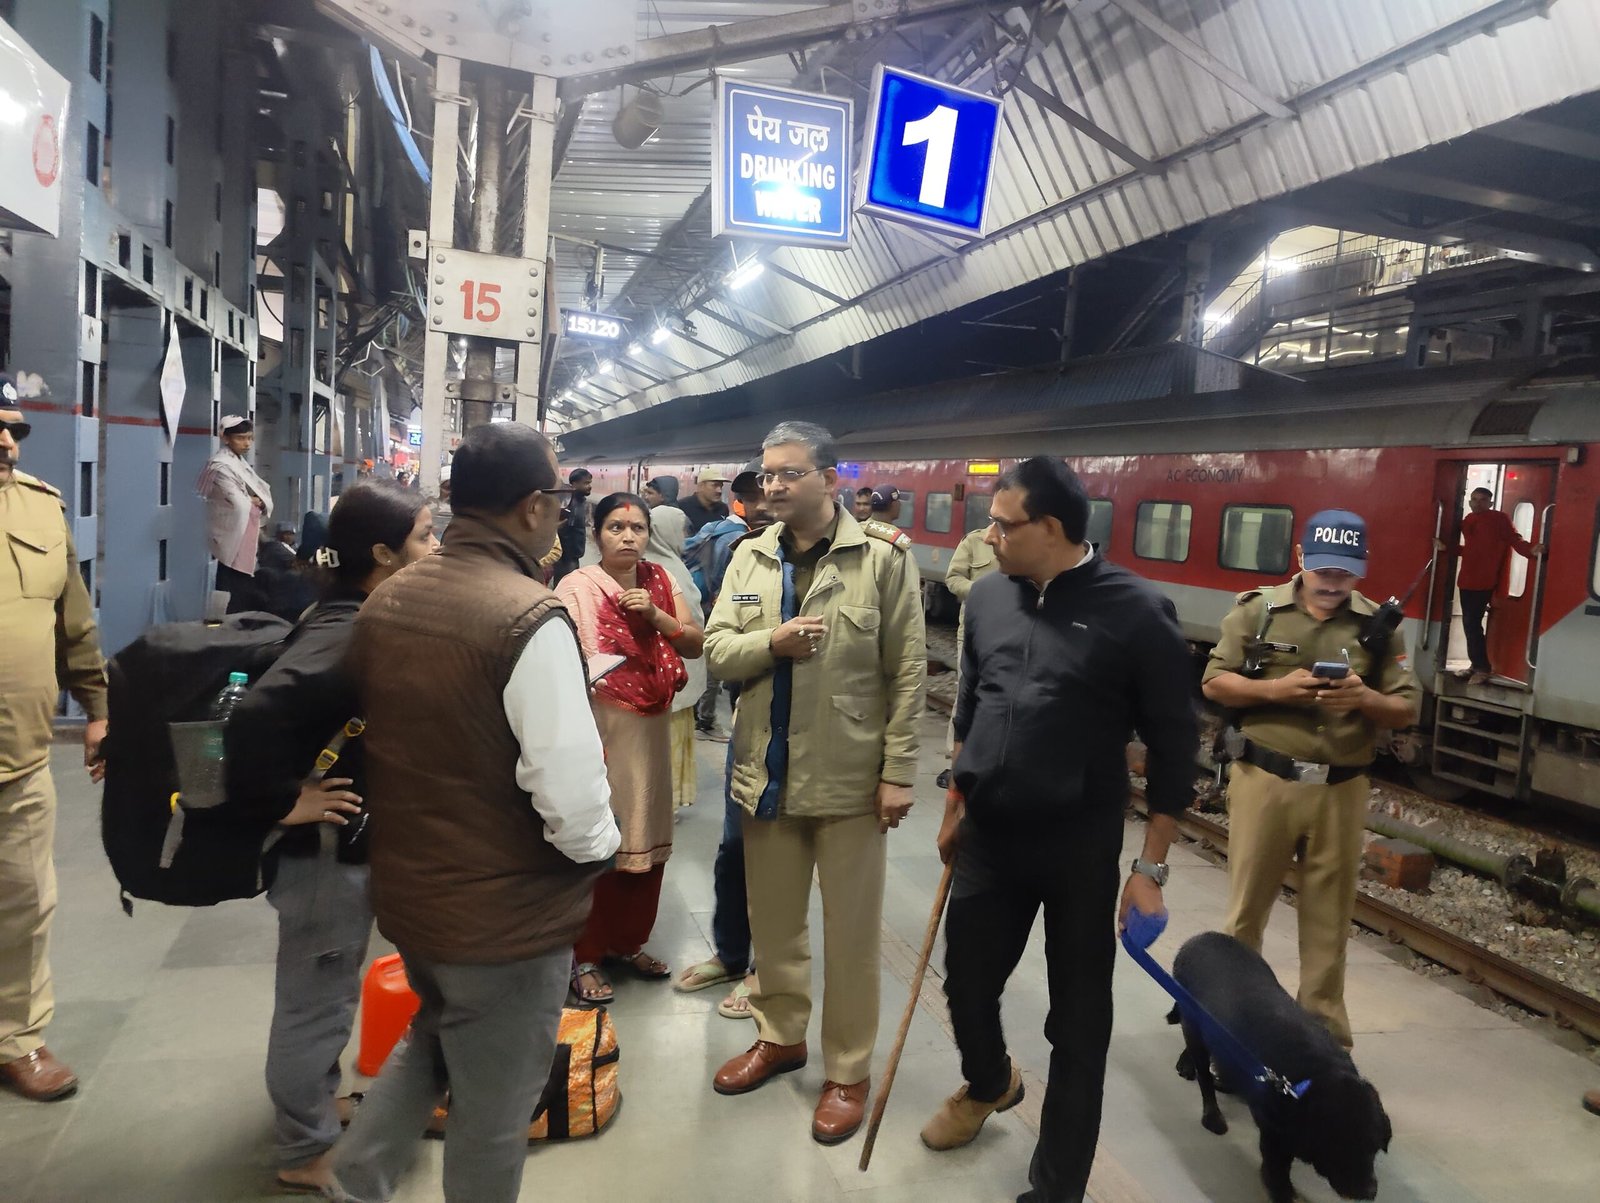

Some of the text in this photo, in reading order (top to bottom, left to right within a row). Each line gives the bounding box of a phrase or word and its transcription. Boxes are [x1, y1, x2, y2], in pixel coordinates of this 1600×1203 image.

[747, 105, 830, 152] पेय जल
[740, 153, 835, 190] DRINKING
[902, 104, 959, 209] 1
[460, 279, 502, 322] 15
[568, 315, 620, 337] 15120
[1167, 469, 1244, 482] AC ECONOMY
[1314, 527, 1360, 546] POLICE
